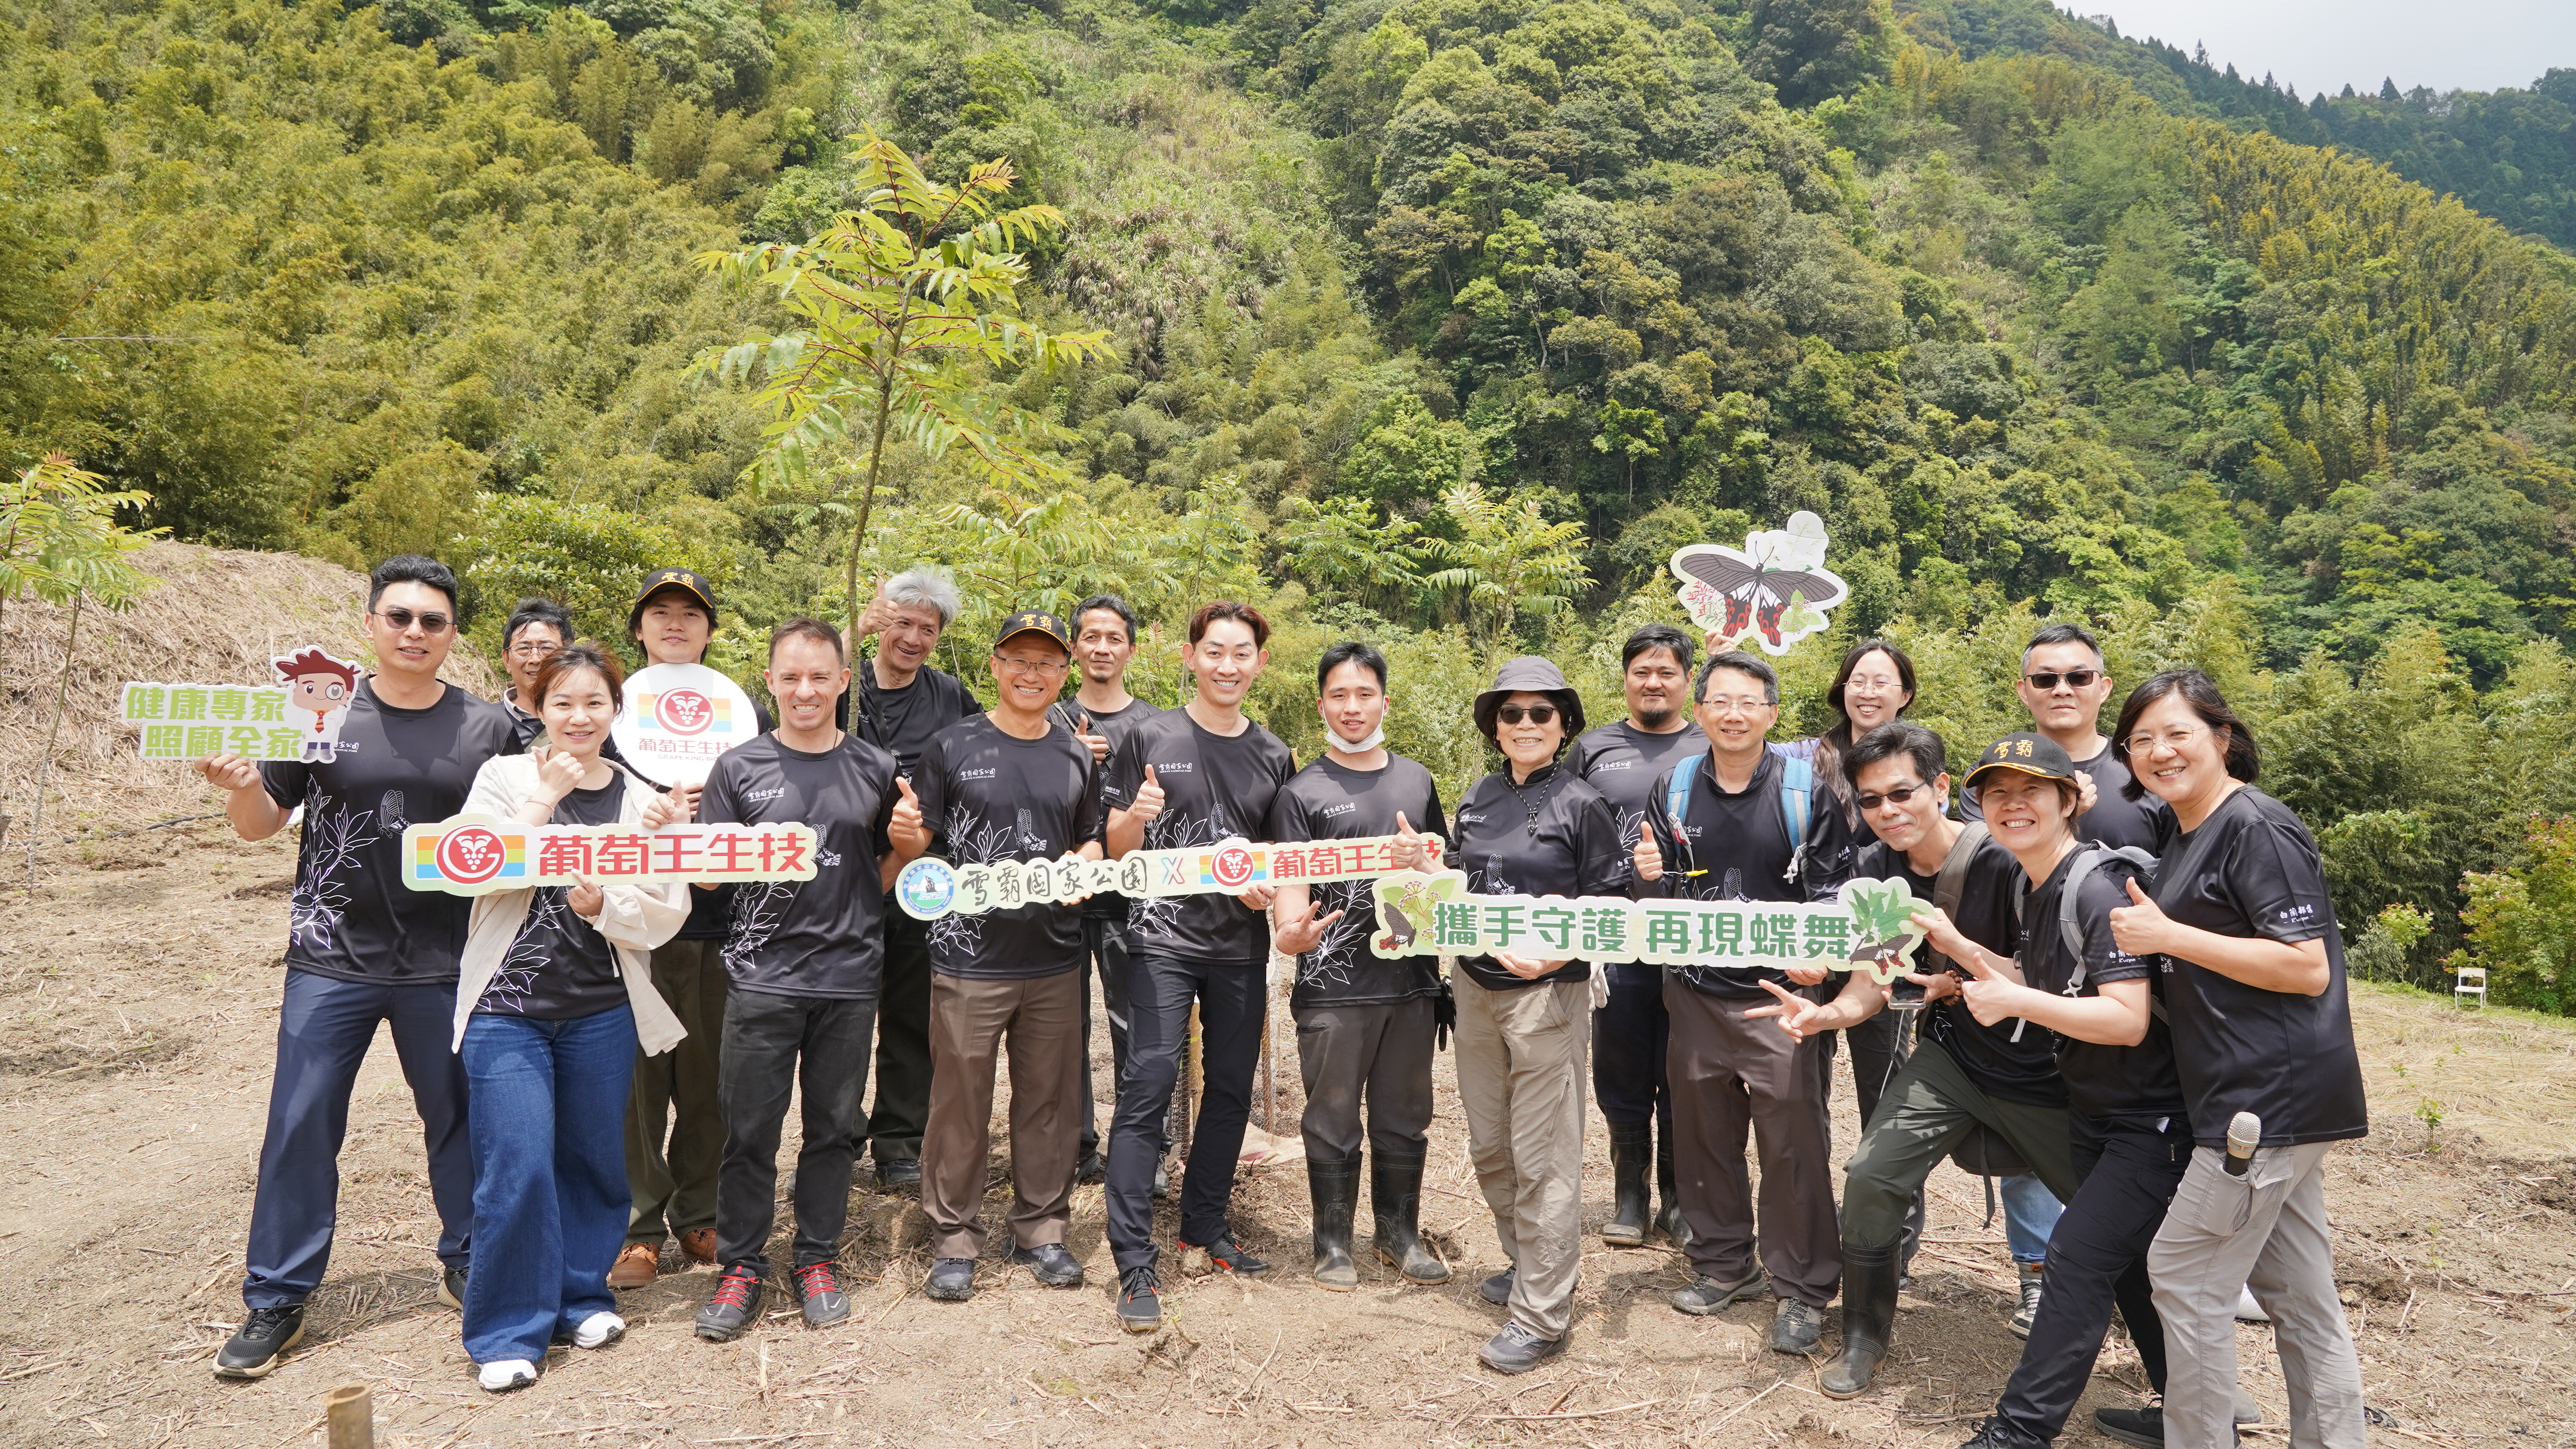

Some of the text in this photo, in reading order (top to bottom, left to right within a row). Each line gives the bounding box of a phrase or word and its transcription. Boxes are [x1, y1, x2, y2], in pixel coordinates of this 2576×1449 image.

[1020, 614, 1051, 630] 雪霸
[126, 686, 287, 721] 健康專家
[144, 725, 301, 758] 照顧全家
[1994, 740, 2033, 758] 雪霸
[539, 832, 807, 876] 葡萄王生技
[962, 856, 1147, 906] 雪霸國家公園
[1161, 857, 1185, 885] X
[906, 898, 920, 911] SHEI-PA
[943, 895, 951, 906] PARK
[1434, 903, 1850, 959] 攜手守護 再現蝶舞
